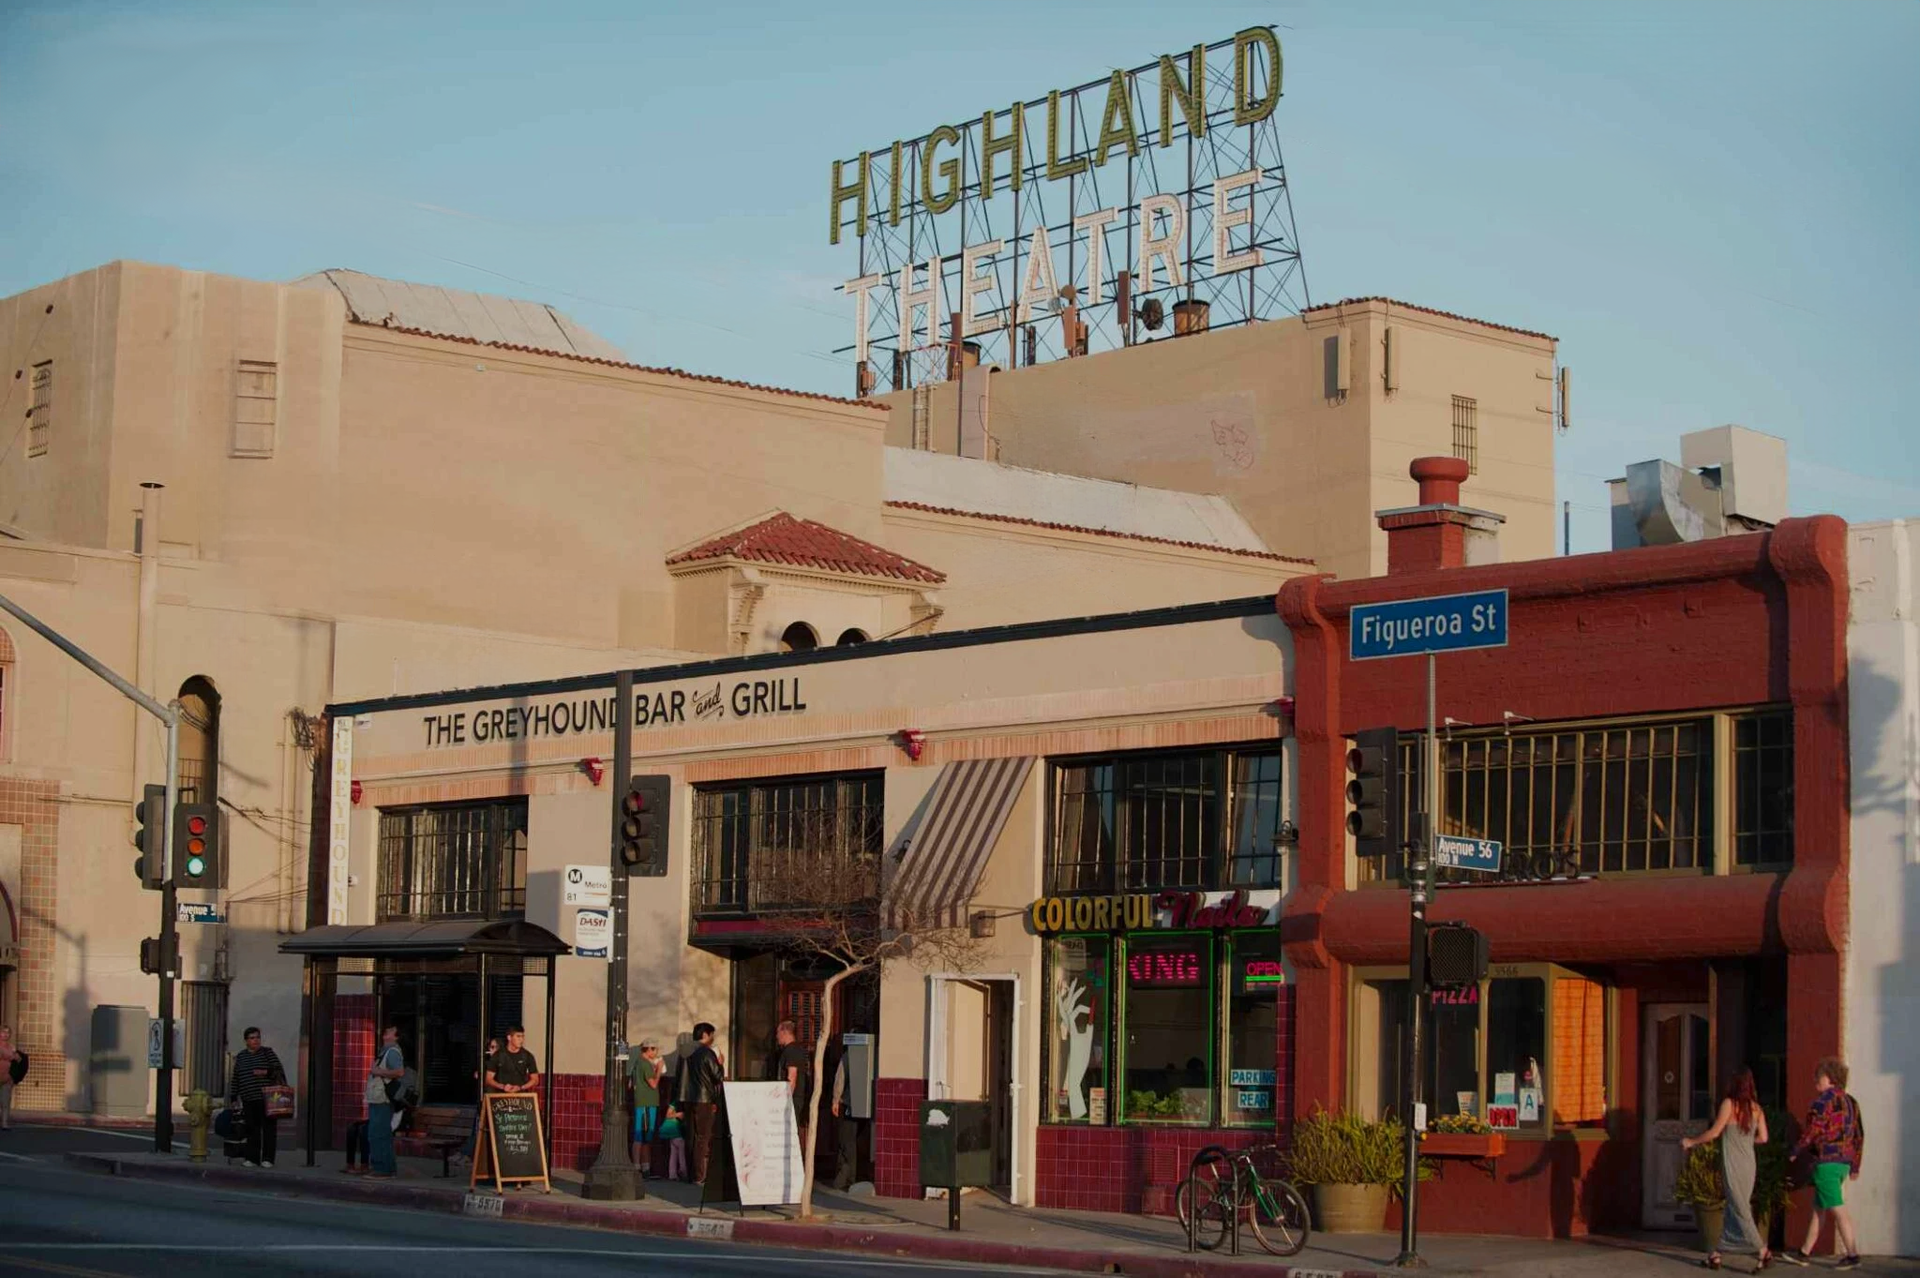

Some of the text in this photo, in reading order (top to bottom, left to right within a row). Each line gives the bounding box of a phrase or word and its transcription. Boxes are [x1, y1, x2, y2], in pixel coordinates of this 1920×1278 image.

[829, 25, 1284, 245] HIGHLAND
[844, 167, 1264, 363] THEATRE
[1361, 603, 1497, 650] Figueroa St
[424, 713, 466, 745] THE
[635, 690, 686, 726] BAR
[692, 682, 725, 720] and
[732, 677, 807, 716] GRILL
[1437, 837, 1493, 860] Avenue 56
[584, 881, 608, 889] Metro
[566, 893, 577, 901] 81
[179, 903, 209, 916] Avenue
[1032, 888, 1268, 931] COLORFUL Nails
[579, 917, 607, 927] DASH
[1245, 961, 1282, 976] OPEN
[1431, 985, 1478, 1004] PIZZA
[1232, 1070, 1276, 1084] PARKING
[1240, 1093, 1268, 1108] REAR
[1525, 1094, 1534, 1109] A
